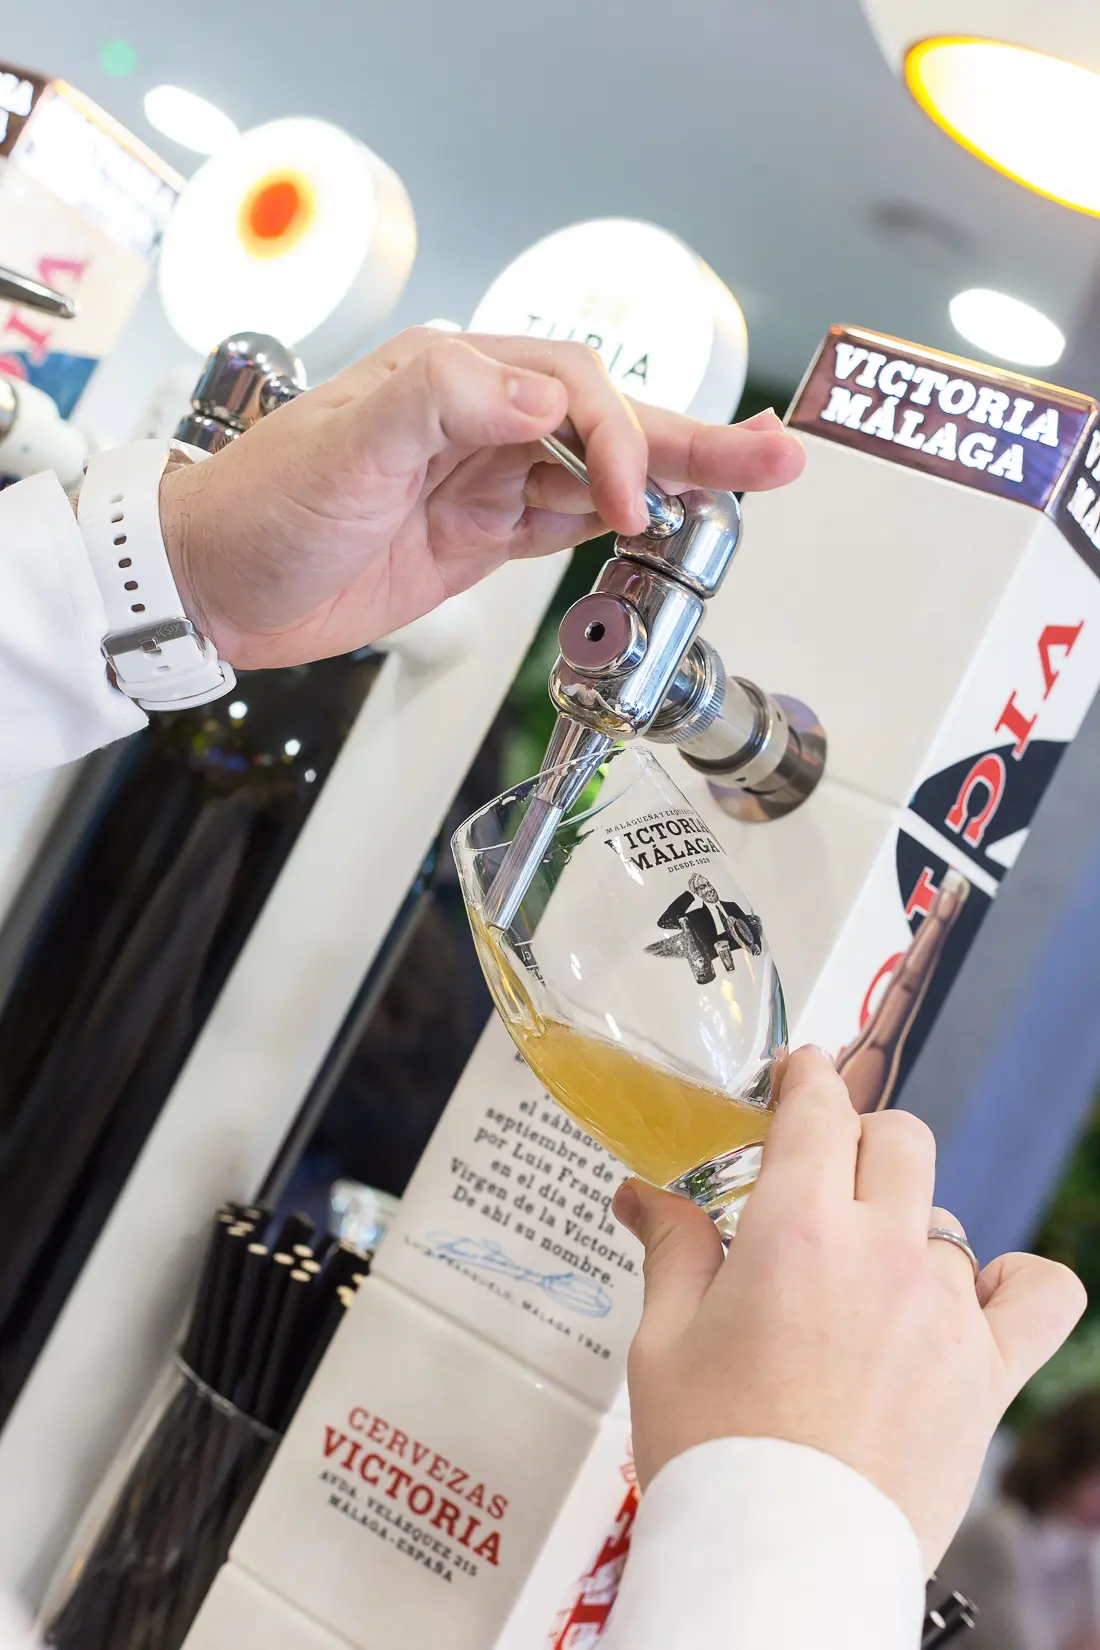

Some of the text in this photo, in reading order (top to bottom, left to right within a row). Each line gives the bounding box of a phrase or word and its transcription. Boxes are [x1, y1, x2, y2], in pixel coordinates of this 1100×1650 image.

[835, 342, 1060, 447] VICTORIA
[820, 386, 1024, 483] MÁLAGA
[155, 623, 183, 638] KSIX
[605, 813, 660, 835] MALAGUEÑA
[667, 860, 696, 873] DESDE
[485, 1107, 614, 1182] septiembre de
[519, 1101, 537, 1117] el
[474, 1126, 508, 1151] por
[512, 1141, 553, 1175] Luis
[451, 1156, 508, 1201] Virgen
[513, 1194, 535, 1215] de
[538, 1206, 557, 1228] la
[491, 1159, 616, 1237] en el día de la
[452, 1184, 615, 1288] De ahí su nombre.
[578, 1332, 612, 1361] 1928
[320, 1424, 504, 1568] VICTORIA
[348, 1405, 510, 1522] CERVEZAS
[454, 1553, 480, 1579] 215
